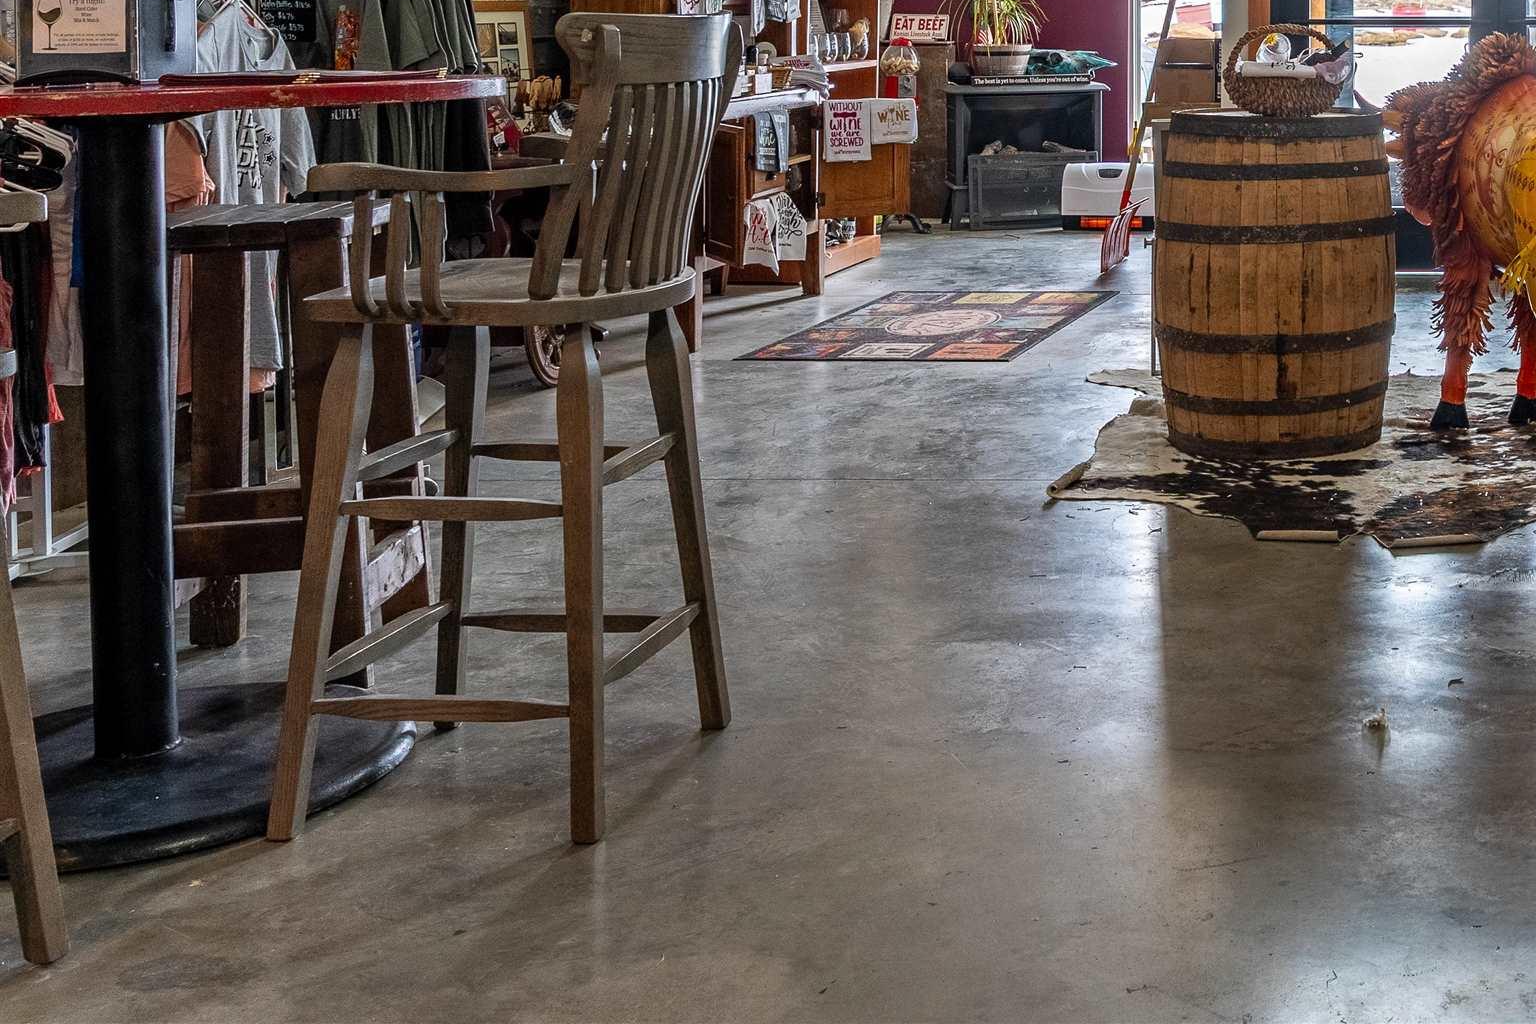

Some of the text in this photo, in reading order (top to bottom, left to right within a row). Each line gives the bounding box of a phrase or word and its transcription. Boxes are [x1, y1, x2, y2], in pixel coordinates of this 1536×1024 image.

[894, 18, 946, 32] EAT BEEF
[1000, 78, 1009, 86] yet
[1046, 77, 1062, 85] you're
[829, 101, 863, 112] WITHOUT
[829, 136, 864, 148] SCREWED
